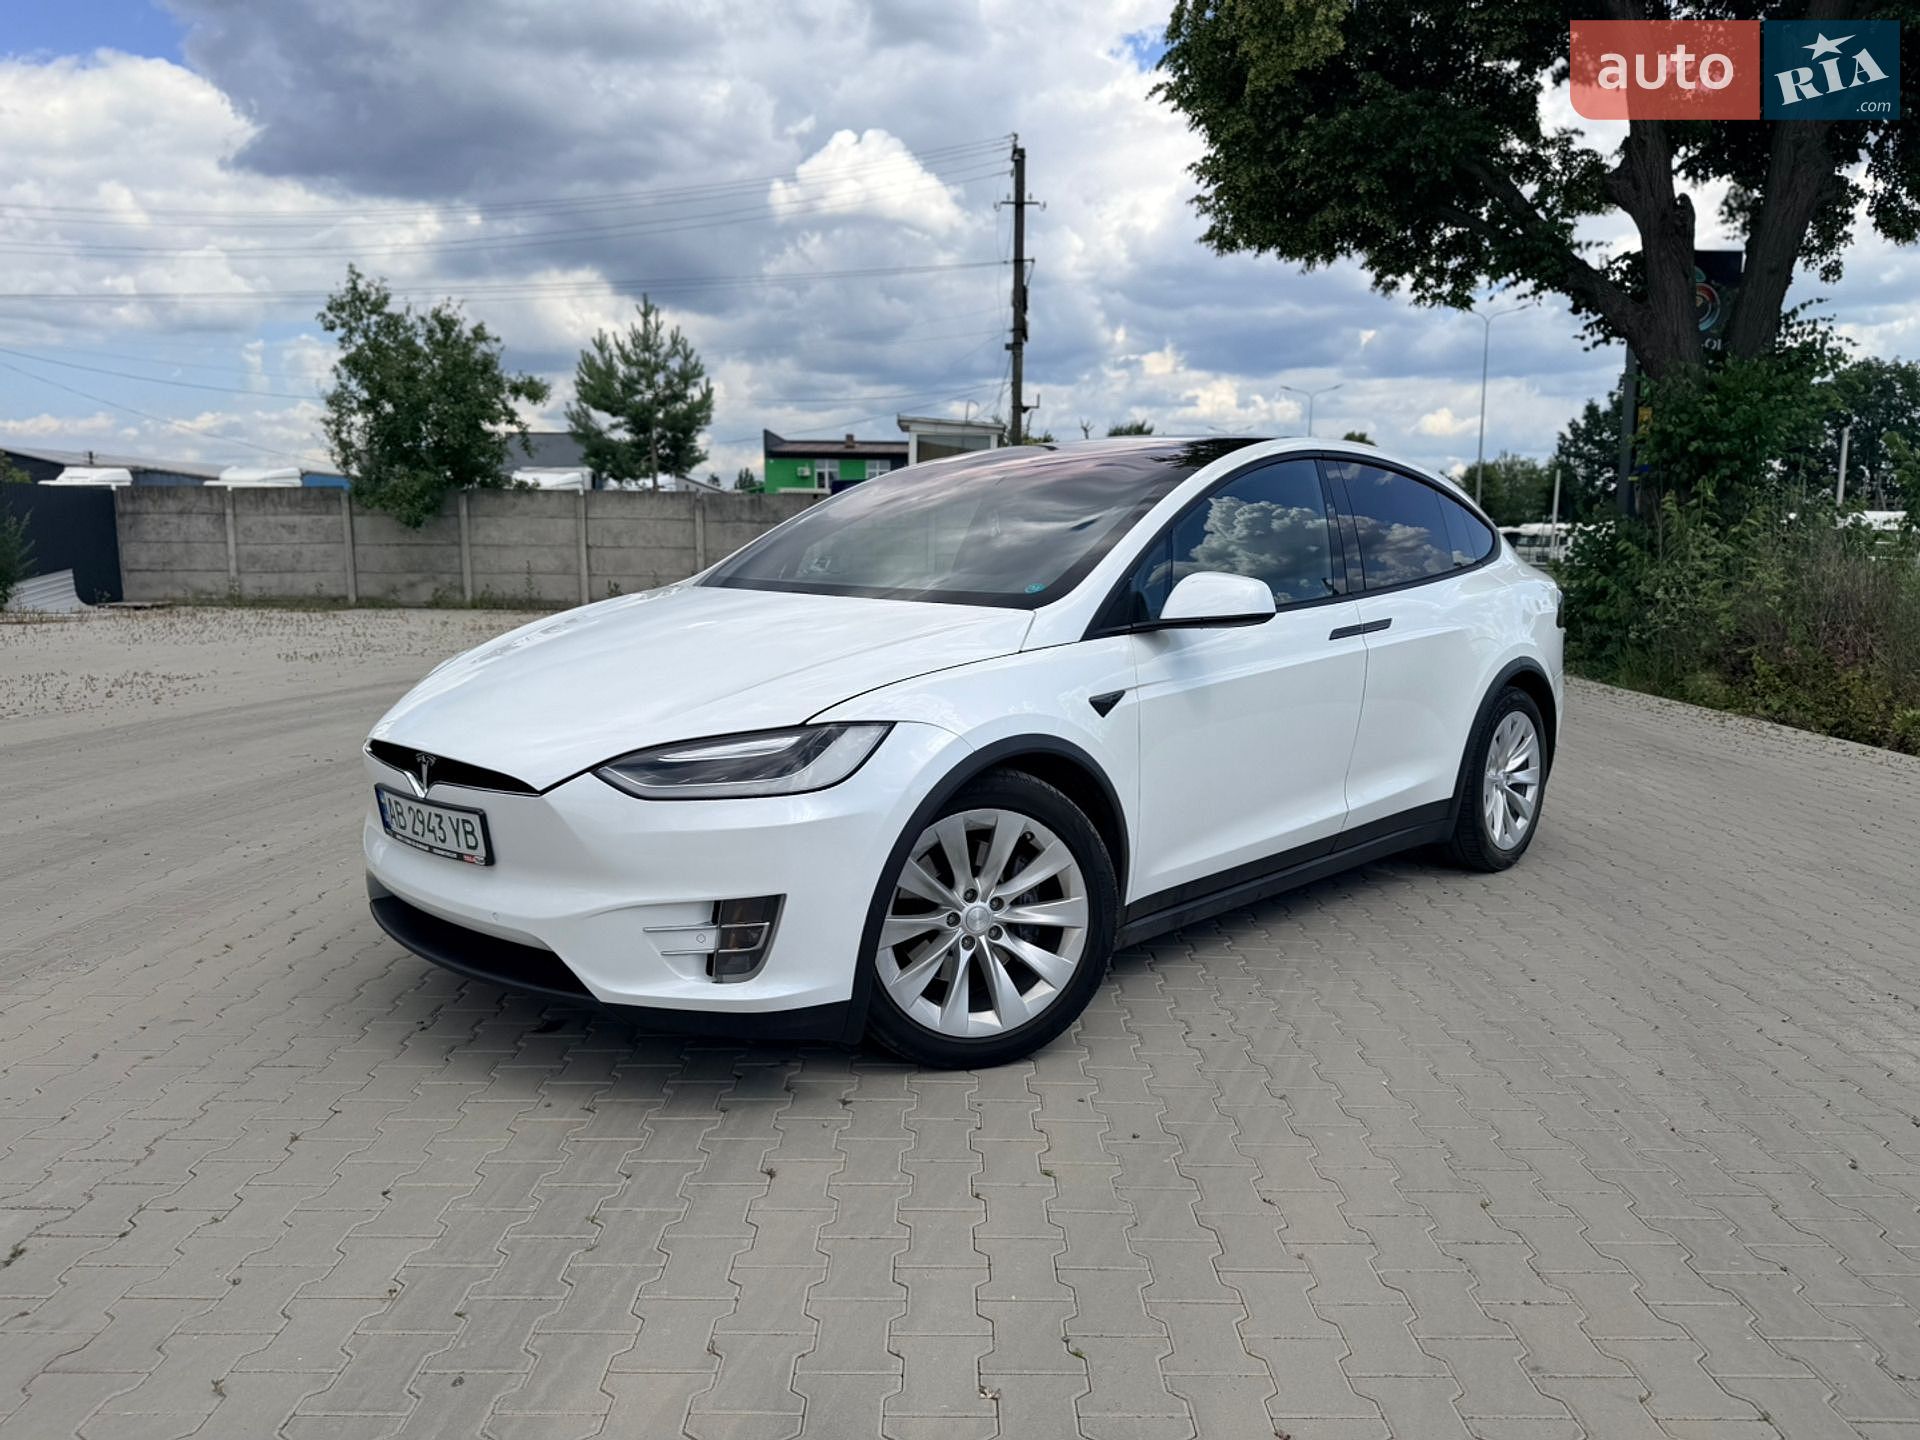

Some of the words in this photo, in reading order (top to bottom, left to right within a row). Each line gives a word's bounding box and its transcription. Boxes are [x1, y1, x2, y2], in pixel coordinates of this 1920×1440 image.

[387, 798, 407, 830] AB
[408, 806, 447, 843] 2943
[449, 816, 479, 850] YB
